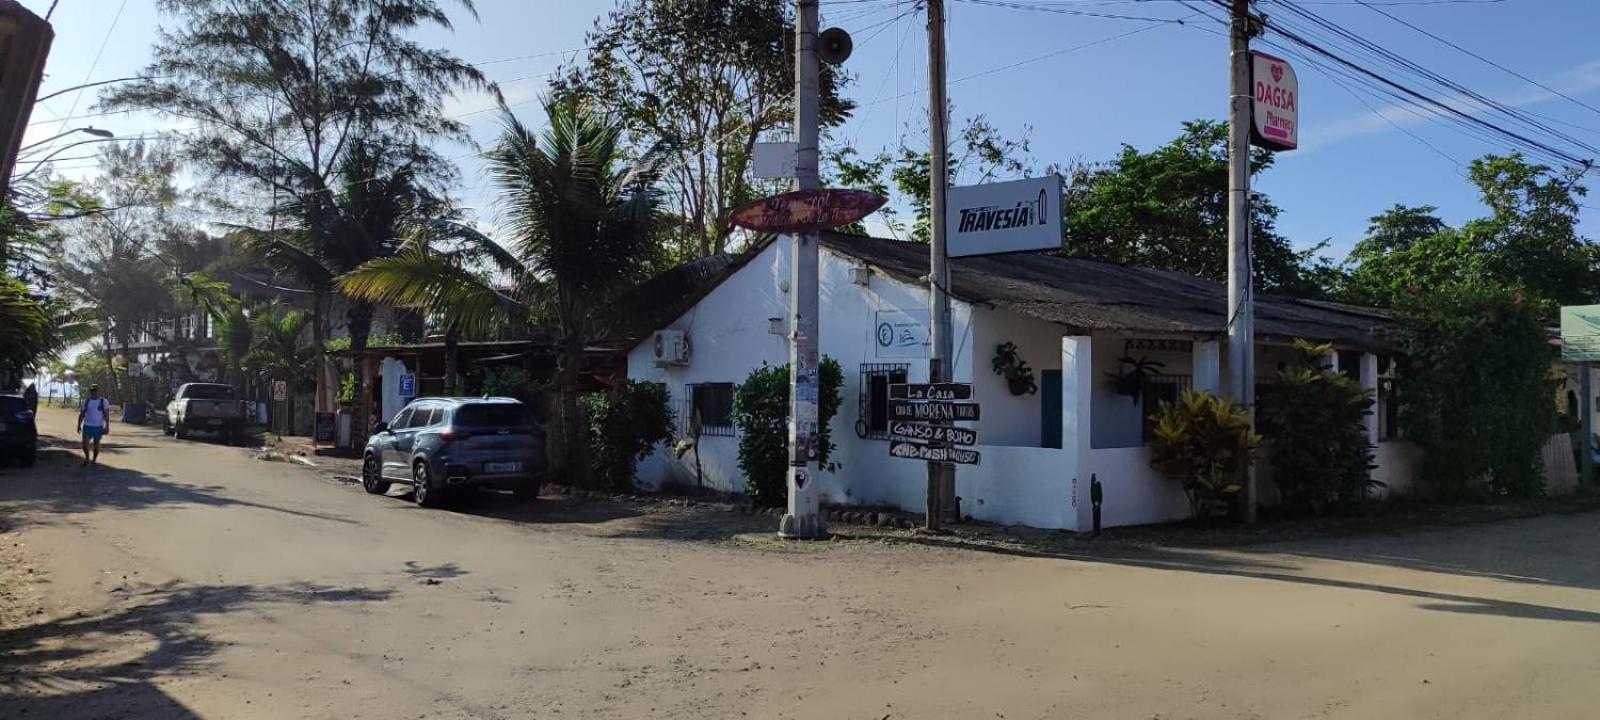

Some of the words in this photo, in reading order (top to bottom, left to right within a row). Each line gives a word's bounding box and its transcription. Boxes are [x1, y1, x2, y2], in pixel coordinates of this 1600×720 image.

[1257, 81, 1295, 112] DAGSA
[1266, 110, 1295, 134] Pharmacy
[907, 386, 922, 398] La
[926, 386, 955, 399] Casa
[914, 403, 954, 418] MORENA
[894, 423, 933, 438] GANSO
[934, 428, 944, 439] &
